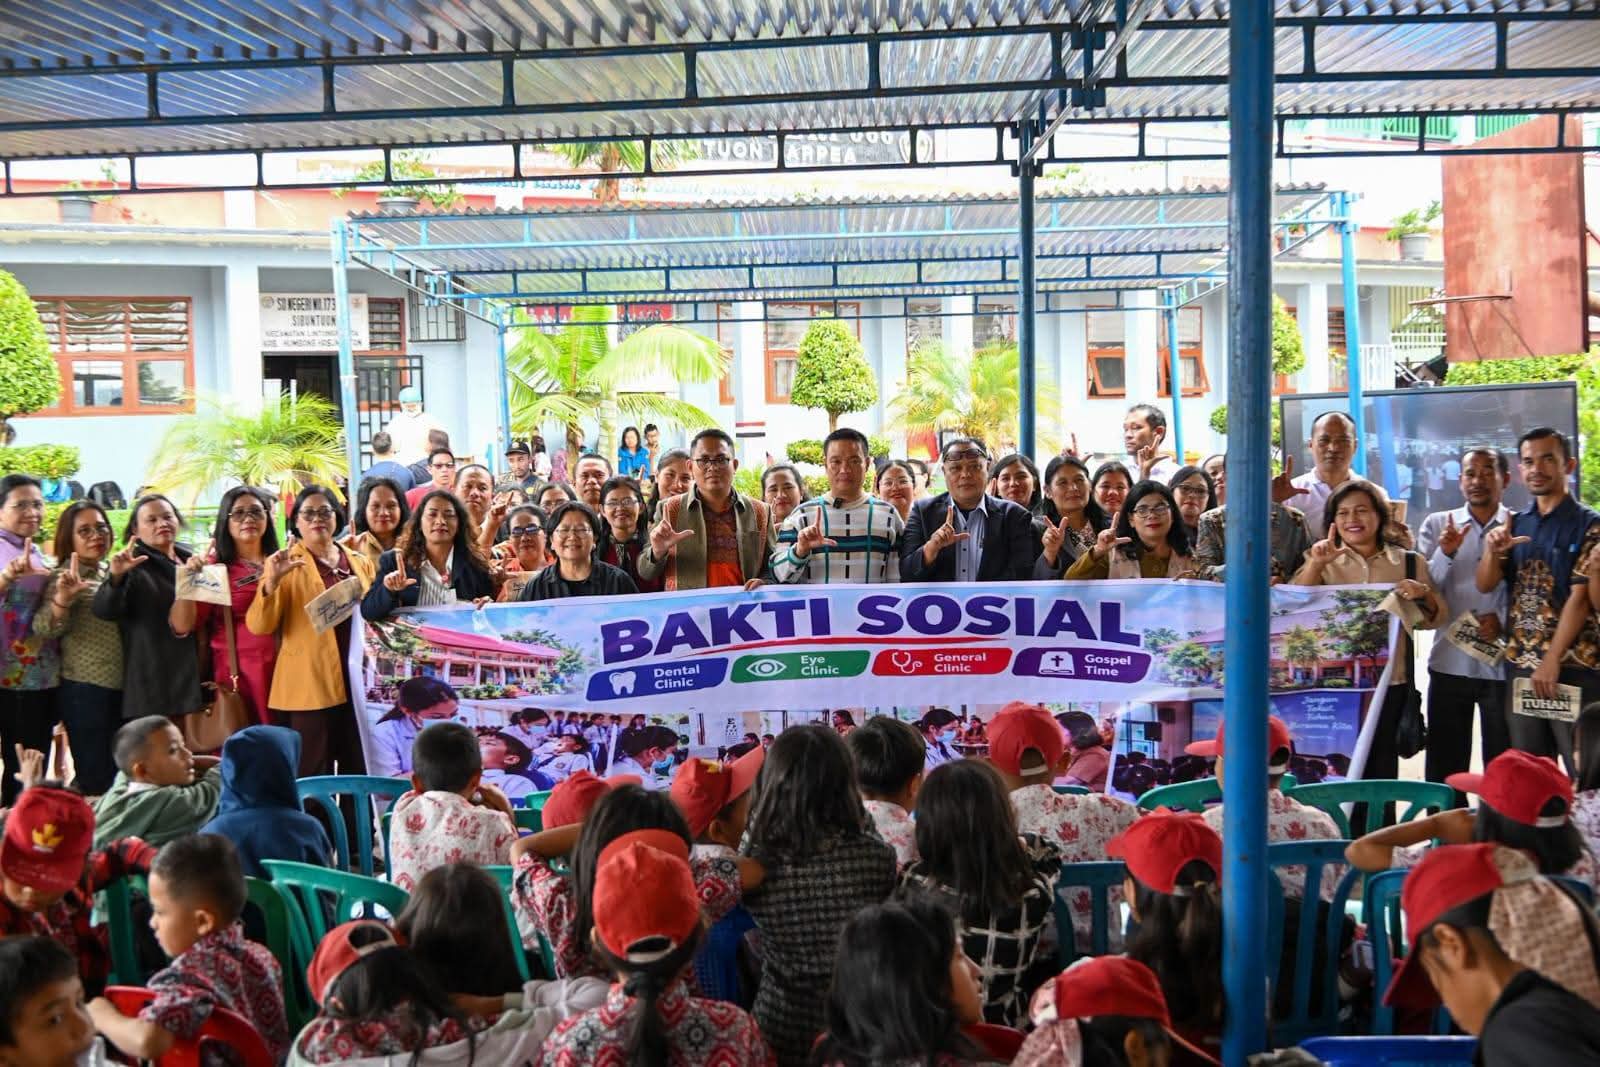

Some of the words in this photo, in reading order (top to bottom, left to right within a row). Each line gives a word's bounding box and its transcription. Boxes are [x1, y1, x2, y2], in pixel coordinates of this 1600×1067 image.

[600, 597, 831, 664] BAKTI
[856, 595, 1141, 647] SOSIAL
[800, 654, 825, 668] Eye
[933, 652, 987, 663] General
[1084, 653, 1132, 666] Gospel
[653, 664, 700, 678] Dental
[800, 665, 840, 676] Clinic
[933, 662, 972, 673] Clinic
[1085, 665, 1120, 676] Time
[654, 677, 694, 690] Clinic
[1523, 699, 1571, 710] TUHAN
